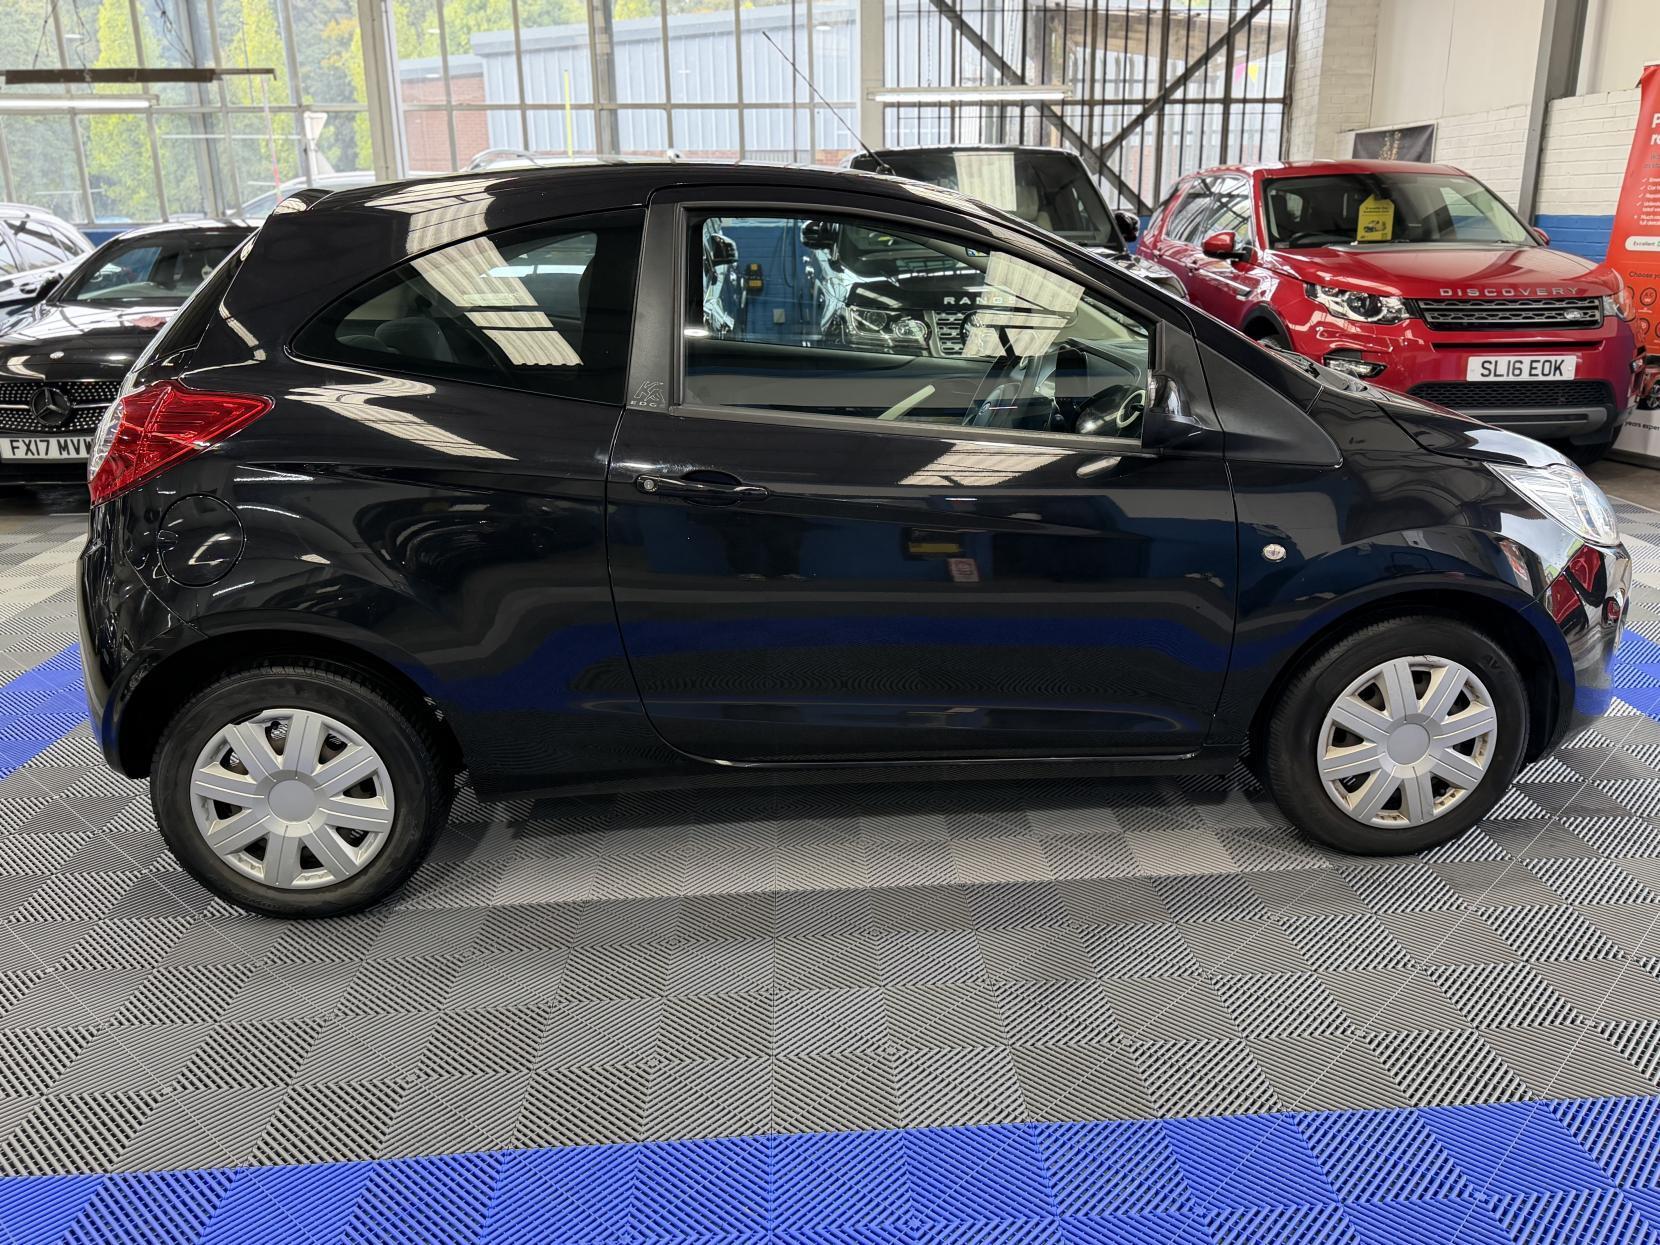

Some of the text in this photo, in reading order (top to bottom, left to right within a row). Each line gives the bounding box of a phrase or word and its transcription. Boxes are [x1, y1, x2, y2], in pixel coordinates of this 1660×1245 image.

[1439, 287, 1579, 297] DISCOVERY
[1480, 359, 1565, 377] SL16 EOK
[9, 439, 51, 456] FX17
